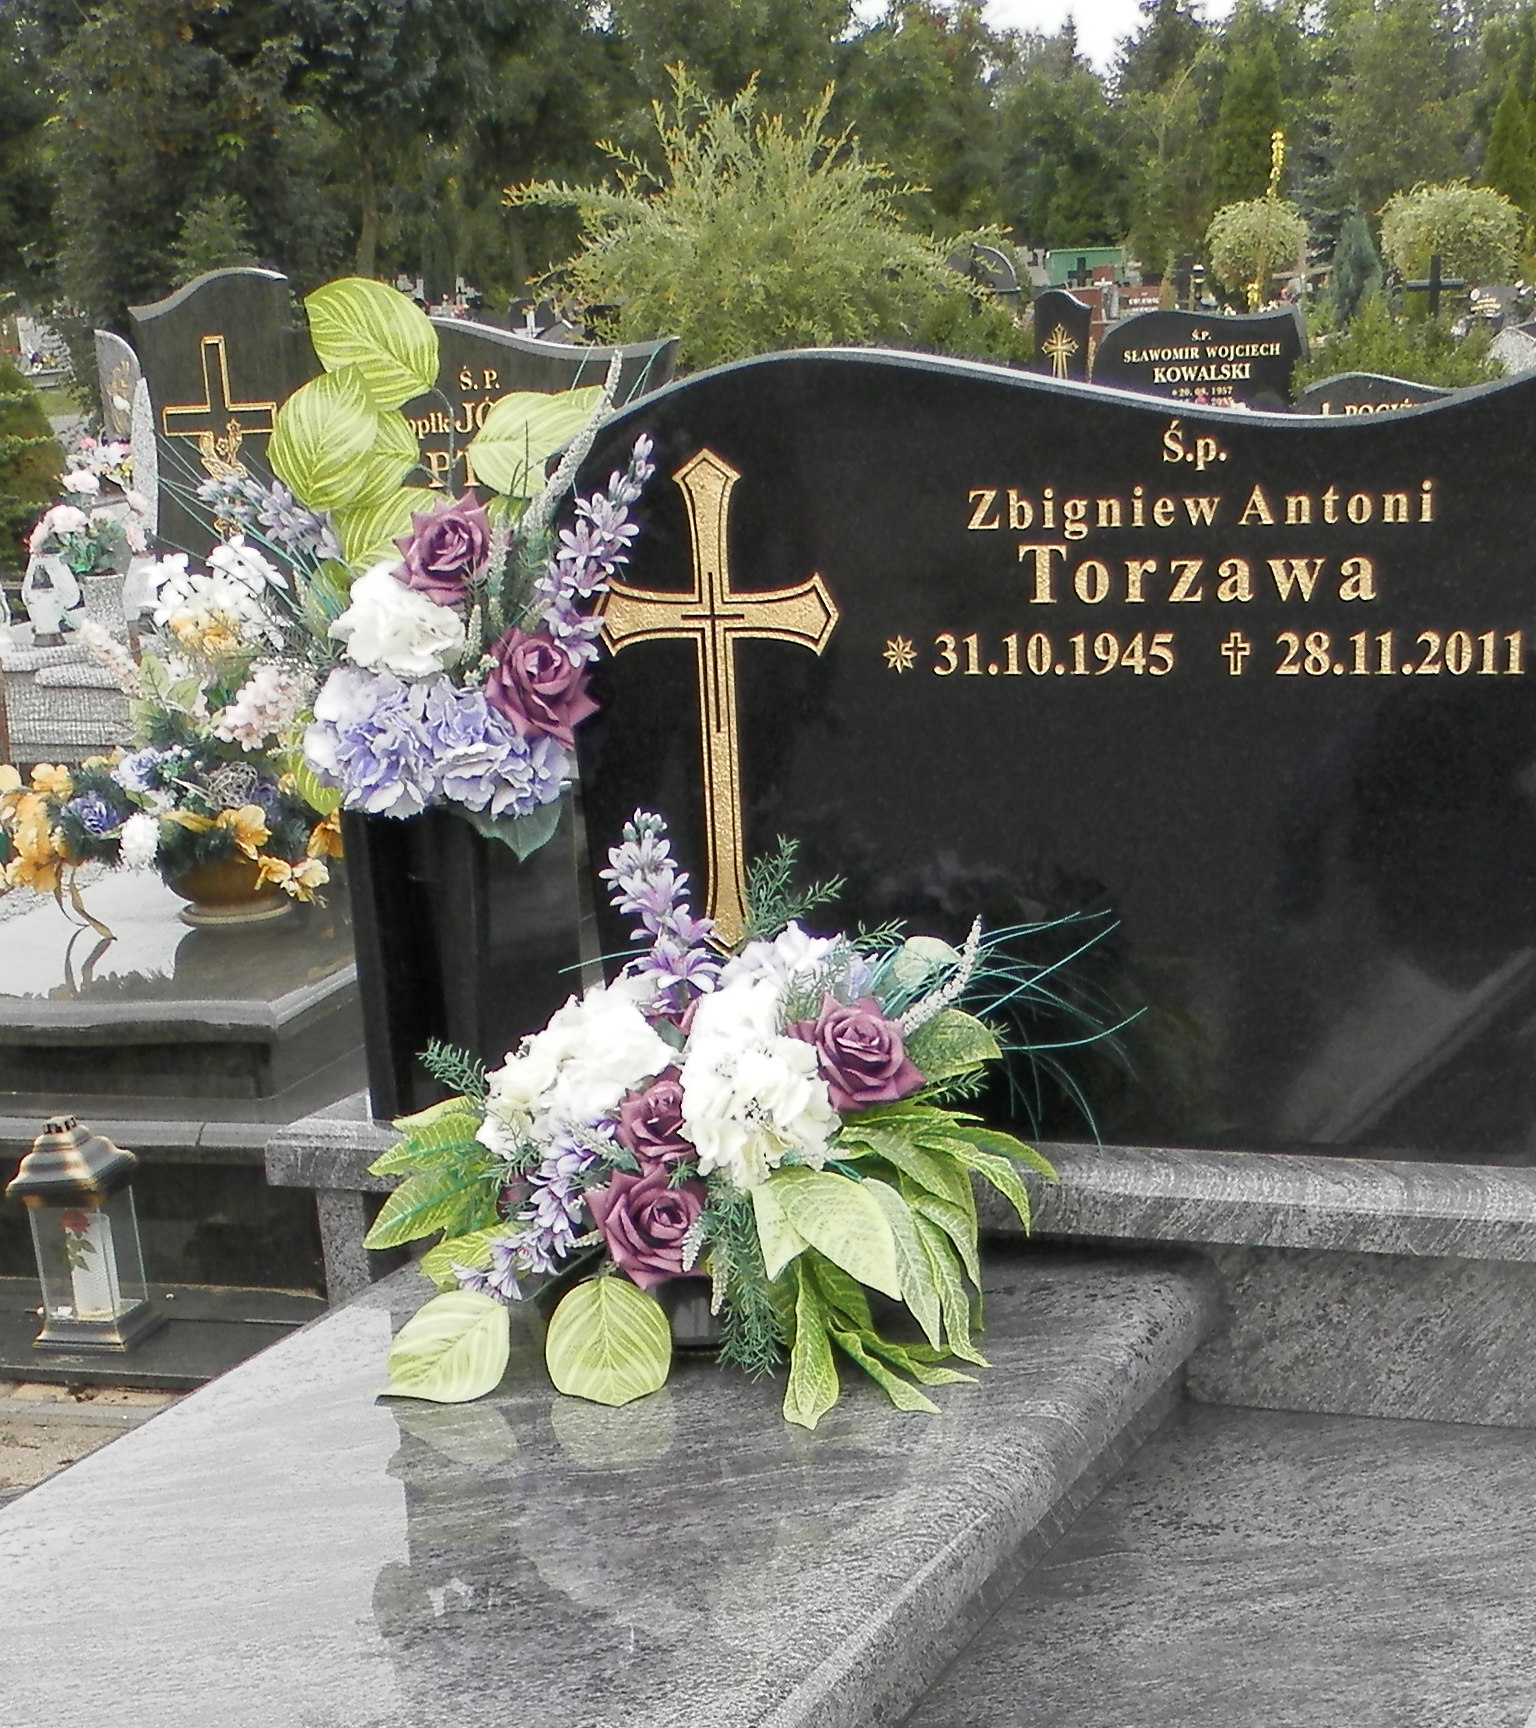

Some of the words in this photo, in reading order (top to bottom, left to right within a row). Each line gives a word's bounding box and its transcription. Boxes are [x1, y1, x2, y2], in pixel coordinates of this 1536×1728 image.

[1123, 346, 1200, 363] SŁAWOMIR
[1206, 343, 1281, 361] WOJCIECH
[1153, 363, 1251, 383] KOWALSKI
[1162, 420, 1227, 471] Ś.p.
[967, 486, 1221, 540] Zbigniew
[1238, 480, 1435, 527] Antoni
[1017, 544, 1378, 604] Torzawa
[932, 632, 1176, 677] 31.10.1945
[1274, 629, 1526, 677] 28.11.2011
